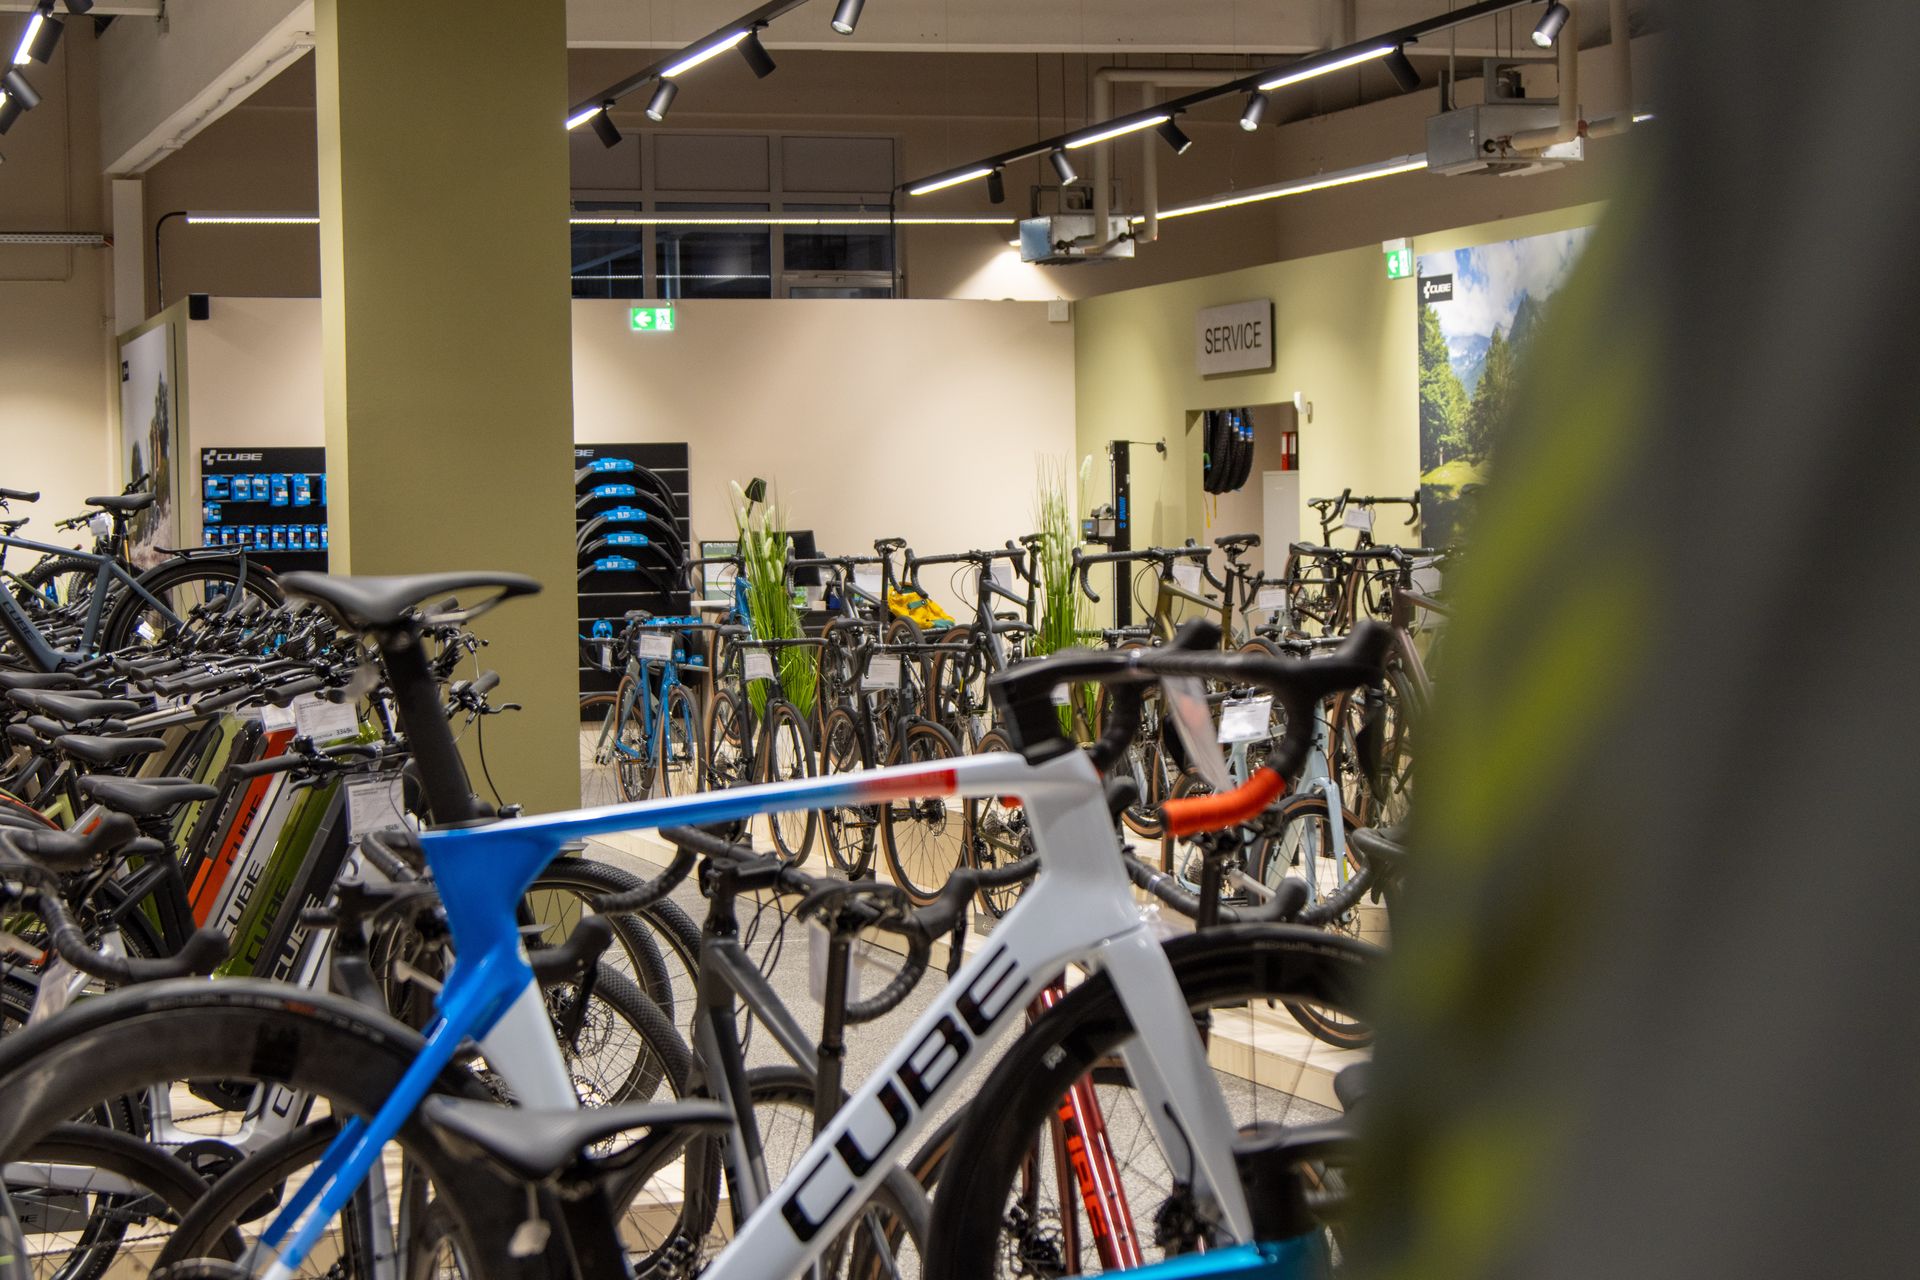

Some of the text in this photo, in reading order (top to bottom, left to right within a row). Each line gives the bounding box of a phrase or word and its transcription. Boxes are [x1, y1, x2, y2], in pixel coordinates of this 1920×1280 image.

[1430, 283, 1452, 294] CUBE
[1205, 321, 1262, 354] SERVICE
[217, 453, 263, 461] CUBE
[574, 449, 594, 457] BE
[3, 601, 37, 641] CUBE
[177, 753, 199, 778] BE
[244, 876, 291, 965] CUBE
[781, 944, 1030, 1242] CUBE
